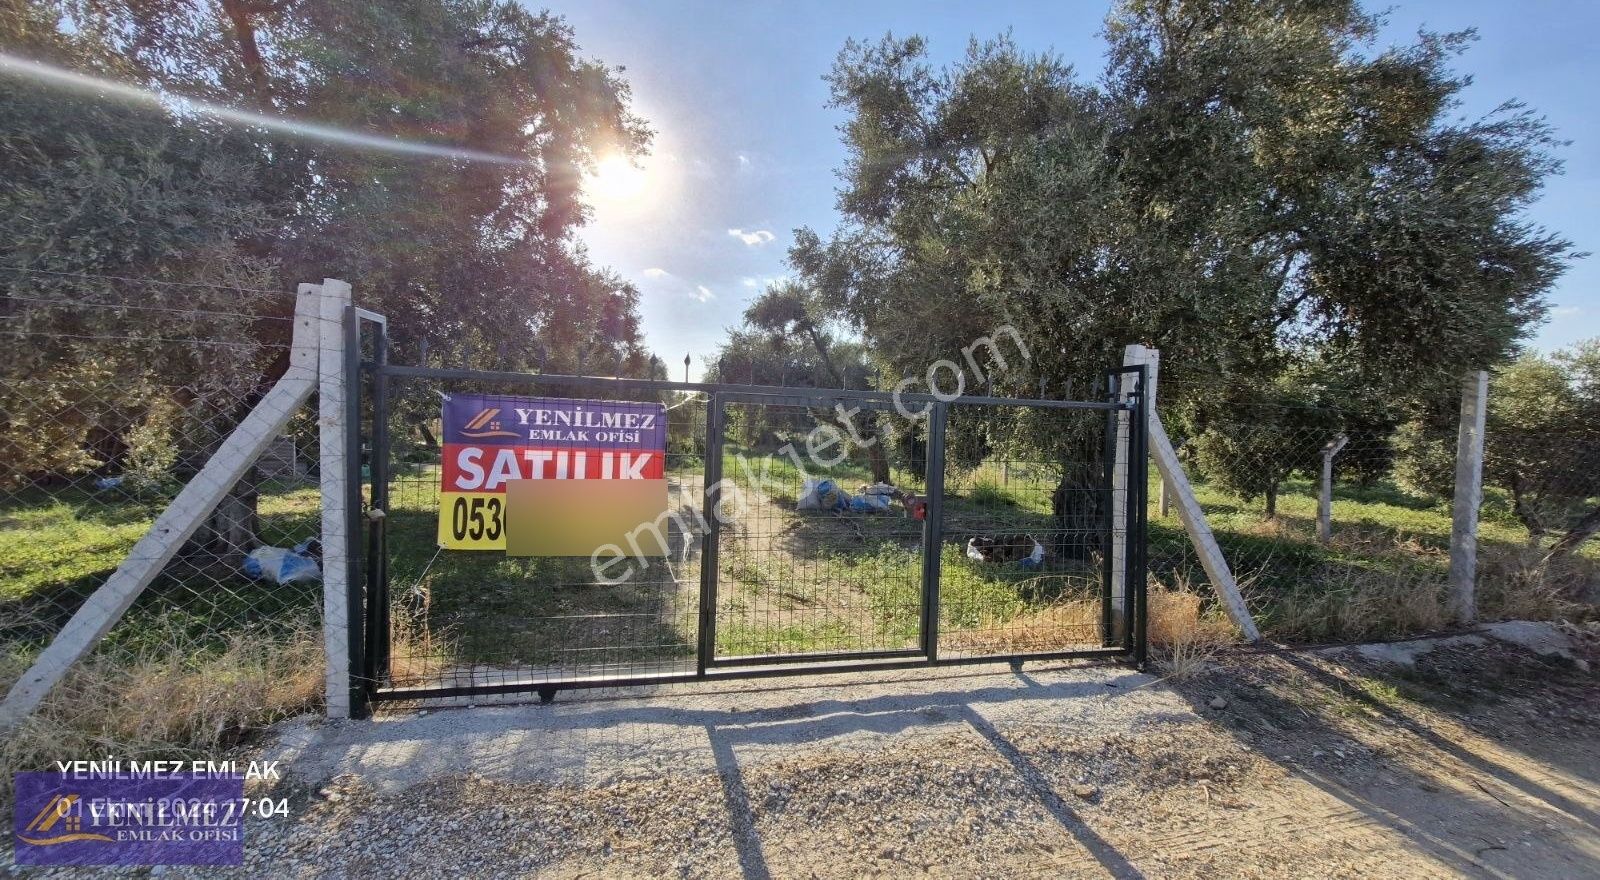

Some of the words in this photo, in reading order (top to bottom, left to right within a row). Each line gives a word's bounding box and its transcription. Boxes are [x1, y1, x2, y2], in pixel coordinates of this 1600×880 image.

[514, 406, 656, 430] YENİLMEZ
[529, 429, 589, 442] EMLAK
[595, 429, 641, 443] OFİSİ
[453, 496, 507, 541] 053
